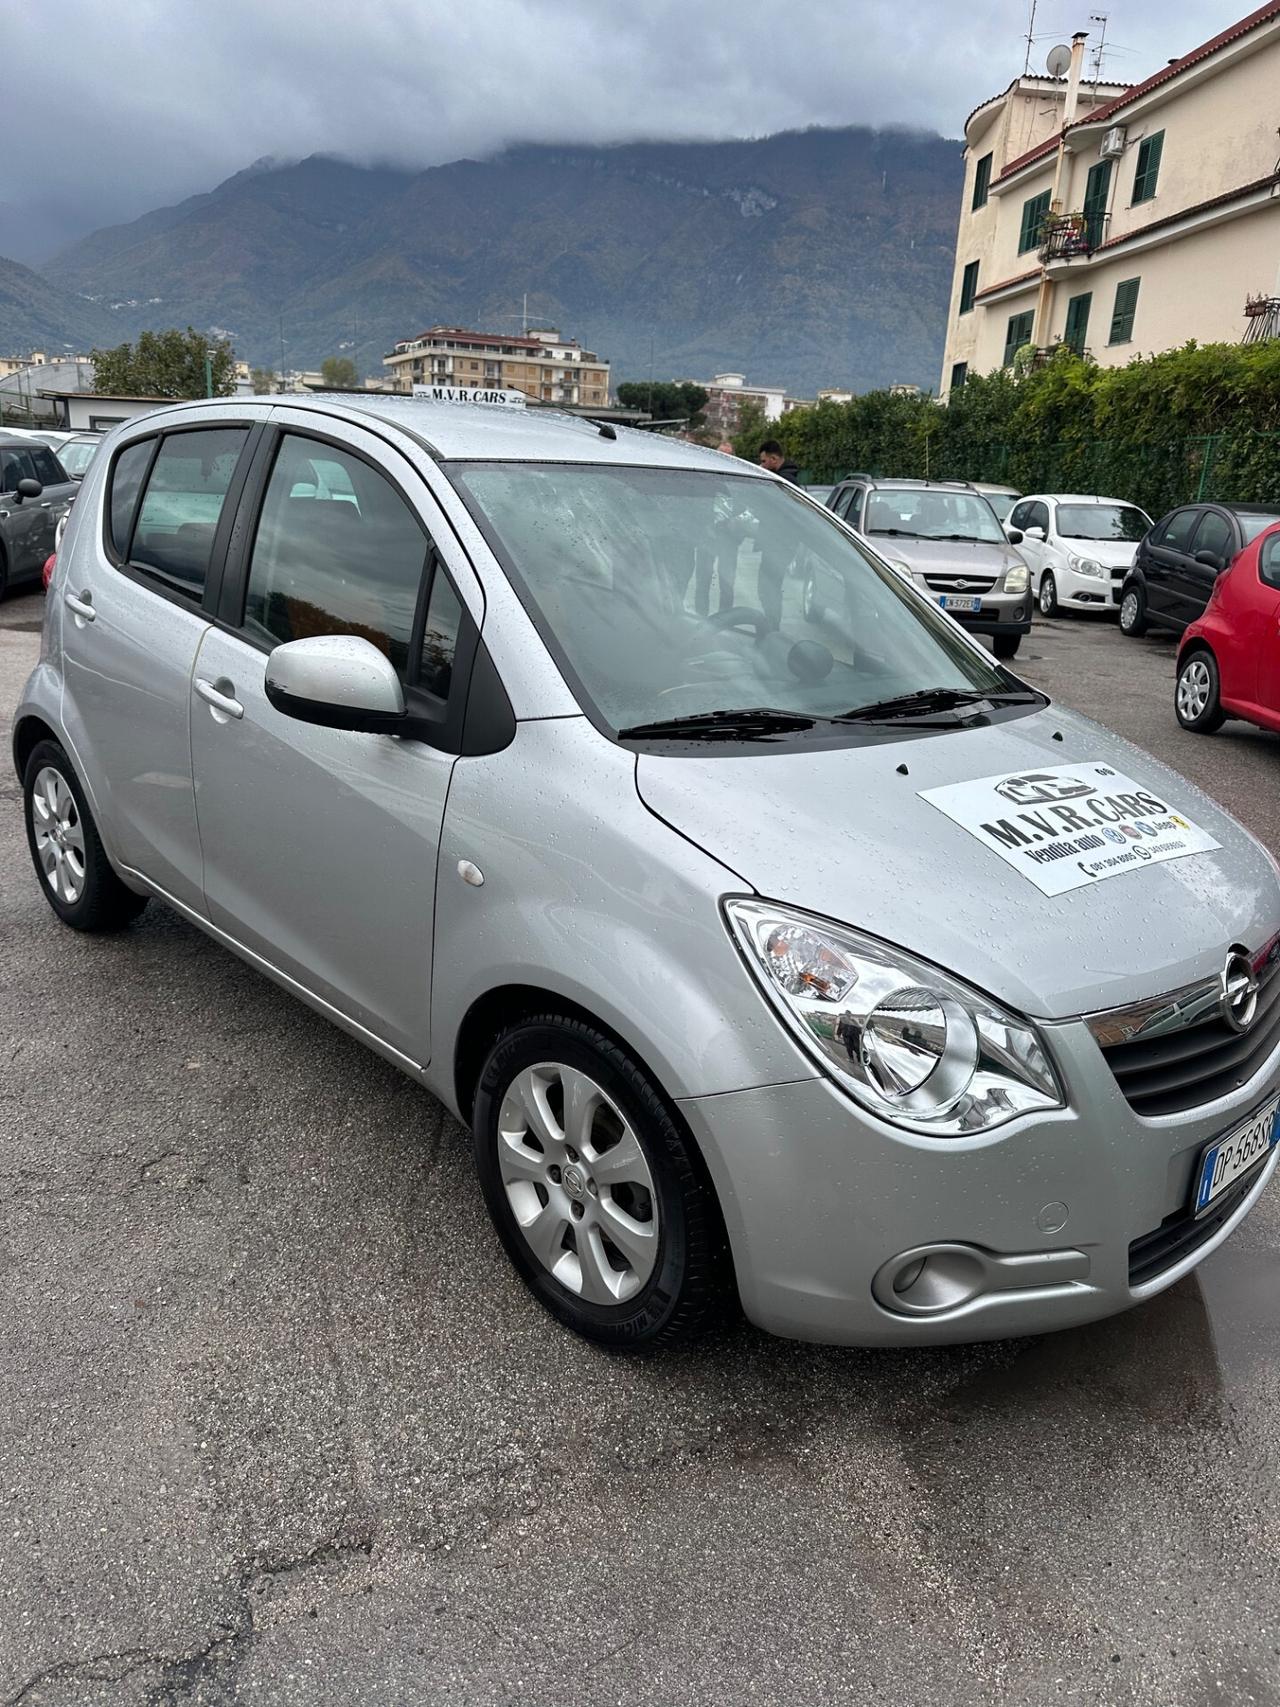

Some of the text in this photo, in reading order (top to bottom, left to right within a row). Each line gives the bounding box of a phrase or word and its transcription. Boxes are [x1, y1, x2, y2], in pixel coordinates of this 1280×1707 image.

[432, 388, 507, 404] M.V.R.CARS
[979, 791, 1168, 849] M.V.R.CARS
[1023, 834, 1106, 864] Vendita auto
[1213, 1110, 1276, 1188] DP 568SR
